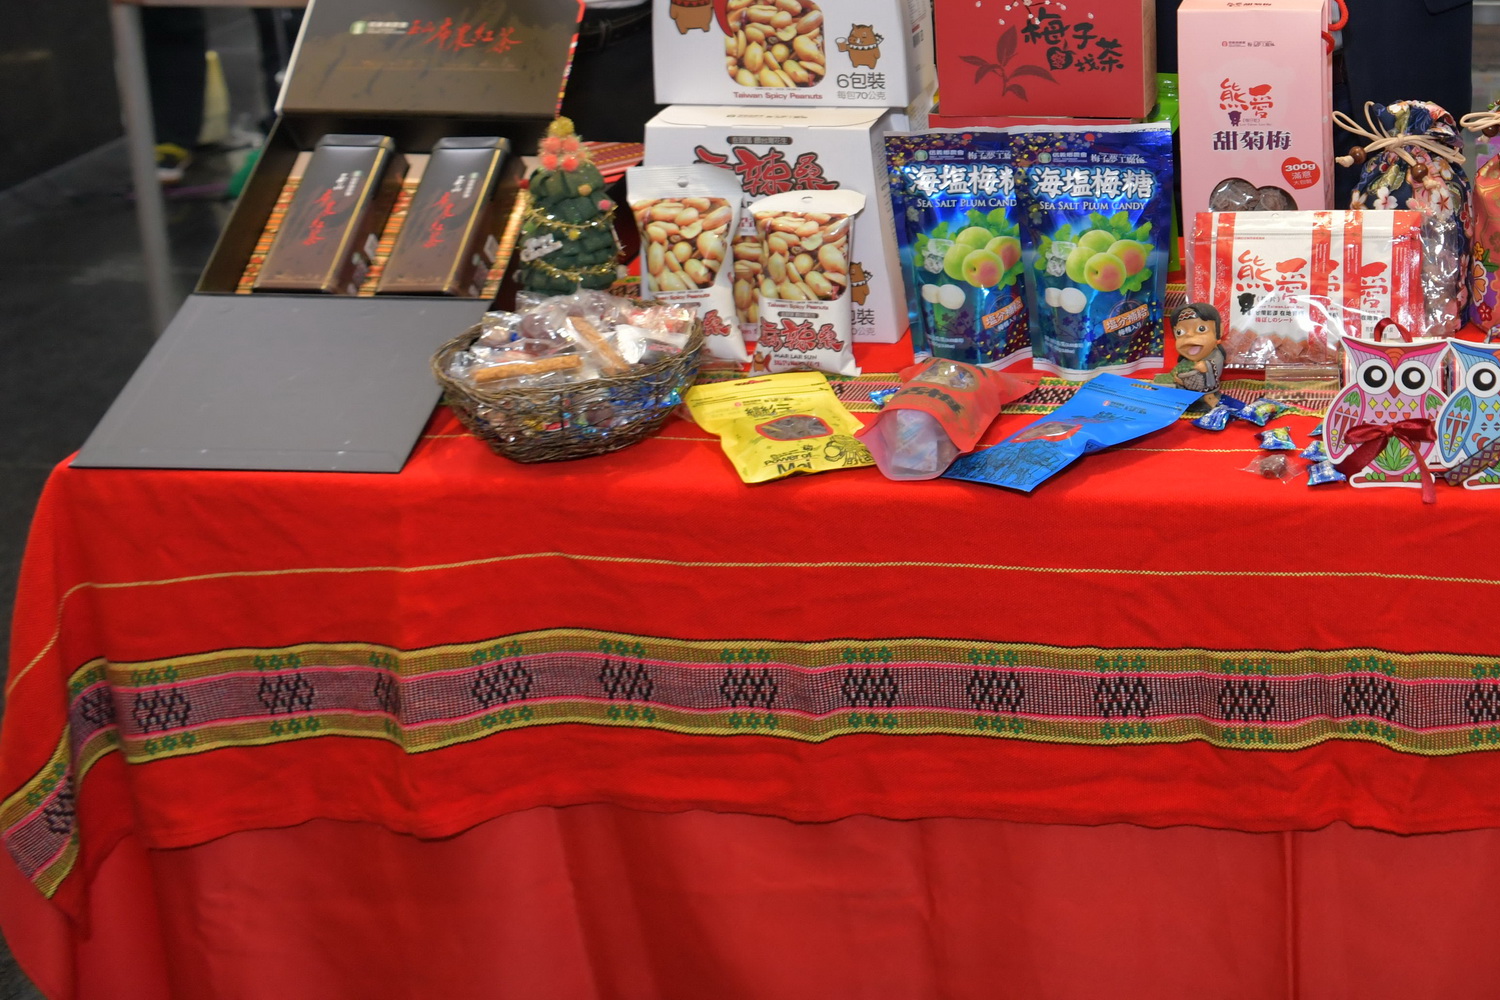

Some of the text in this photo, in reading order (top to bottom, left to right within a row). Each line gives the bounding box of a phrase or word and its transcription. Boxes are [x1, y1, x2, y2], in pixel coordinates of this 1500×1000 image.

[836, 72, 886, 90] 6包裝
[733, 91, 823, 100] Taiwan Spicy Peanuts
[1213, 130, 1292, 151] 甜菊梅
[1285, 163, 1316, 172] 300g
[1031, 166, 1155, 199] 海塩梅糖
[988, 198, 1017, 206] CAND
[1040, 201, 1146, 210] SEA SALT PLUM CANDY
